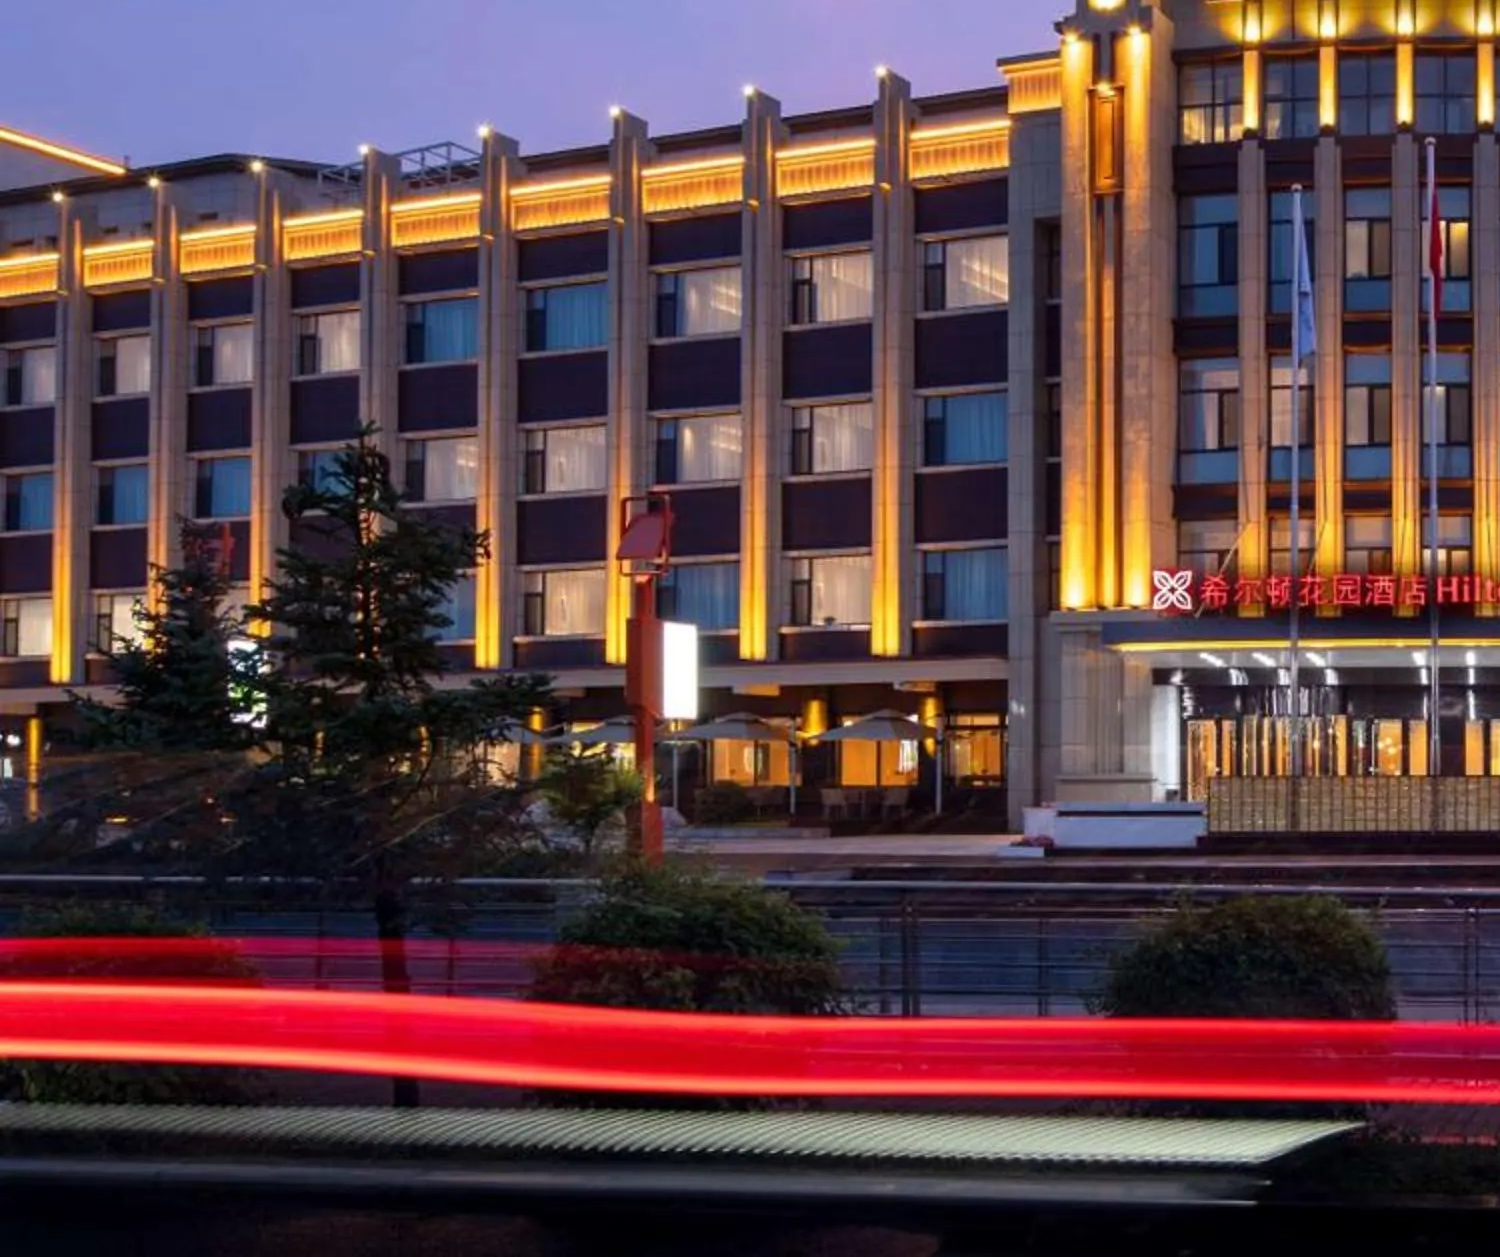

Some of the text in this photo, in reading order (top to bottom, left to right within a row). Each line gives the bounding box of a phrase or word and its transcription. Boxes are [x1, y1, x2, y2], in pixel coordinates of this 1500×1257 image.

[1200, 574, 1427, 606] 希尔顿花园酒店
